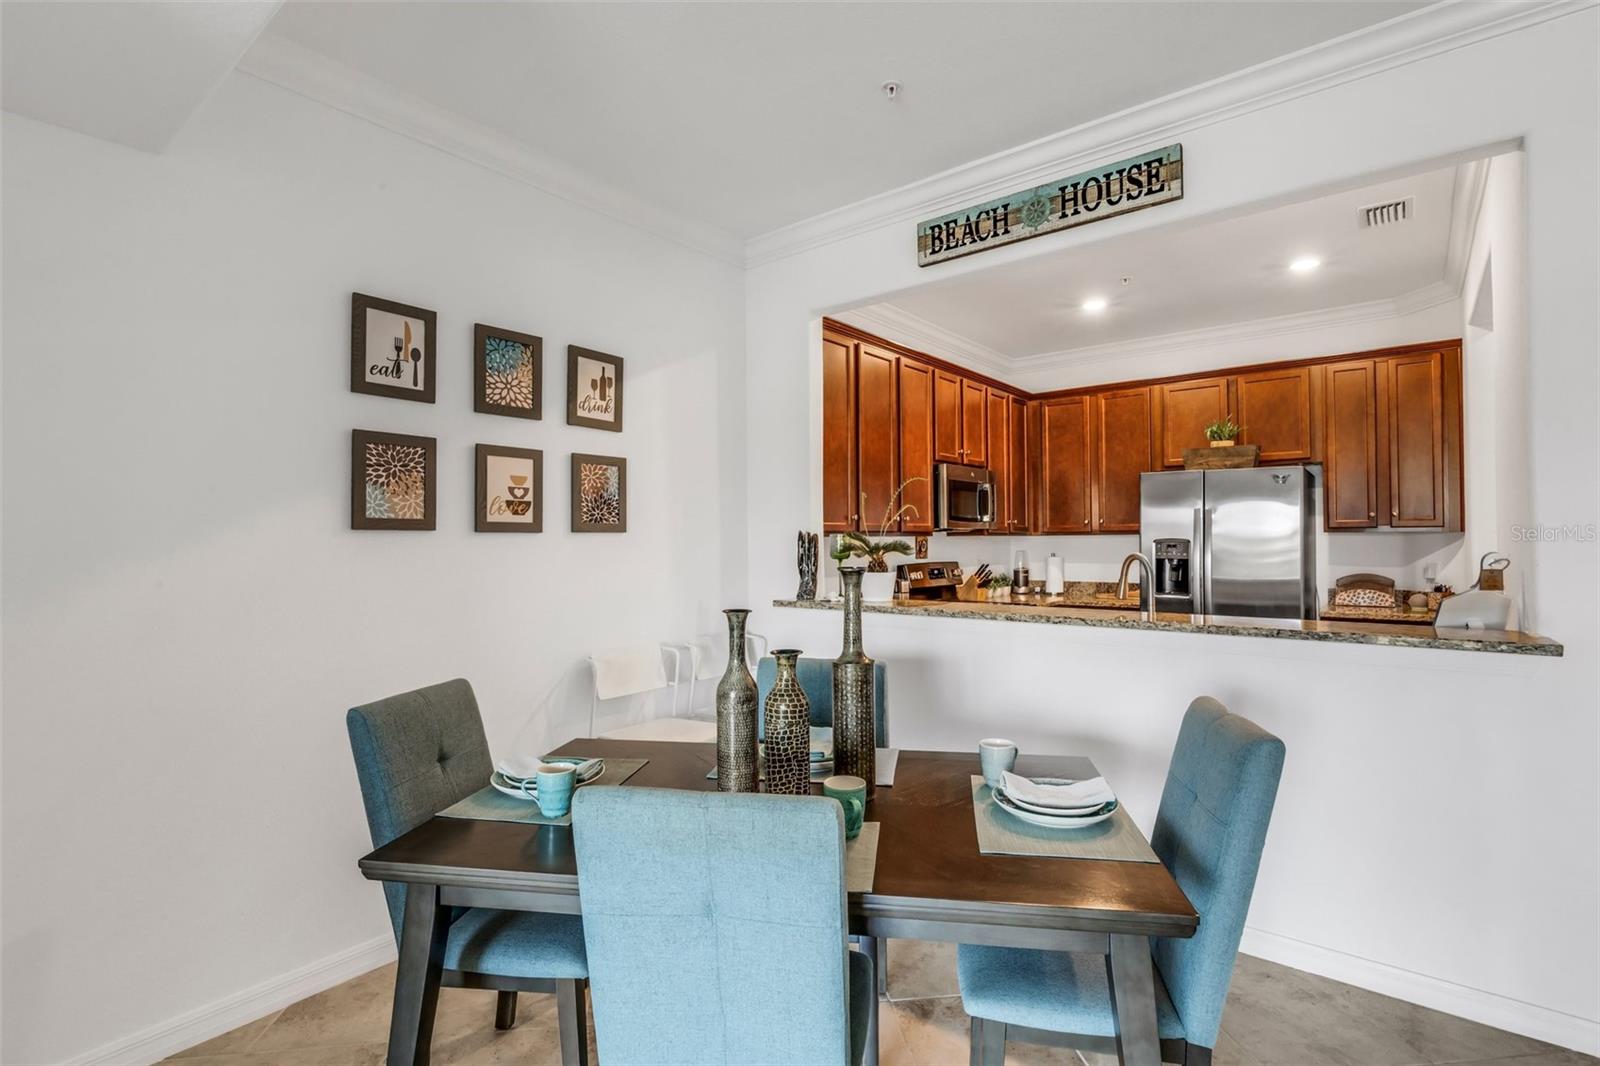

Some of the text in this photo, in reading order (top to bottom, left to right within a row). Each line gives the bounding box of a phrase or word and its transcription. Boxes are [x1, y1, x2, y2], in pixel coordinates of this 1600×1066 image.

[929, 157, 1166, 255] BEACH HOUSE
[369, 356, 409, 380] eat
[578, 394, 614, 414] drink
[489, 495, 529, 516] love
